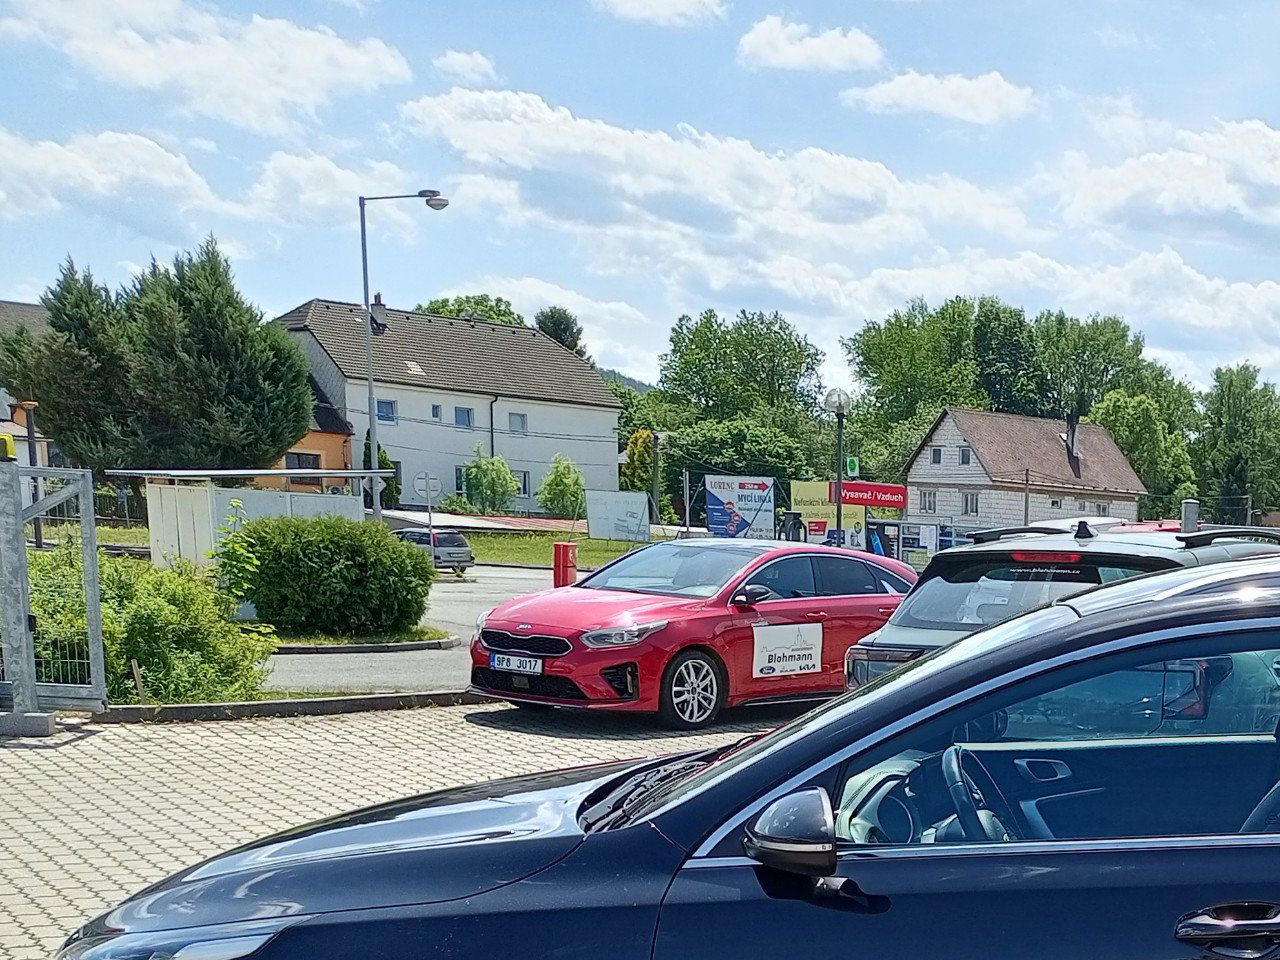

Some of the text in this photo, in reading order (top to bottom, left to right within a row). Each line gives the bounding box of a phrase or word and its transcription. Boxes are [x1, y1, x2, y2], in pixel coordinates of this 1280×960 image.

[841, 488, 873, 500] Vysavač
[876, 492, 904, 502] Vzduch
[496, 656, 538, 670] 9P8 3017
[768, 652, 812, 664] Blohmann
